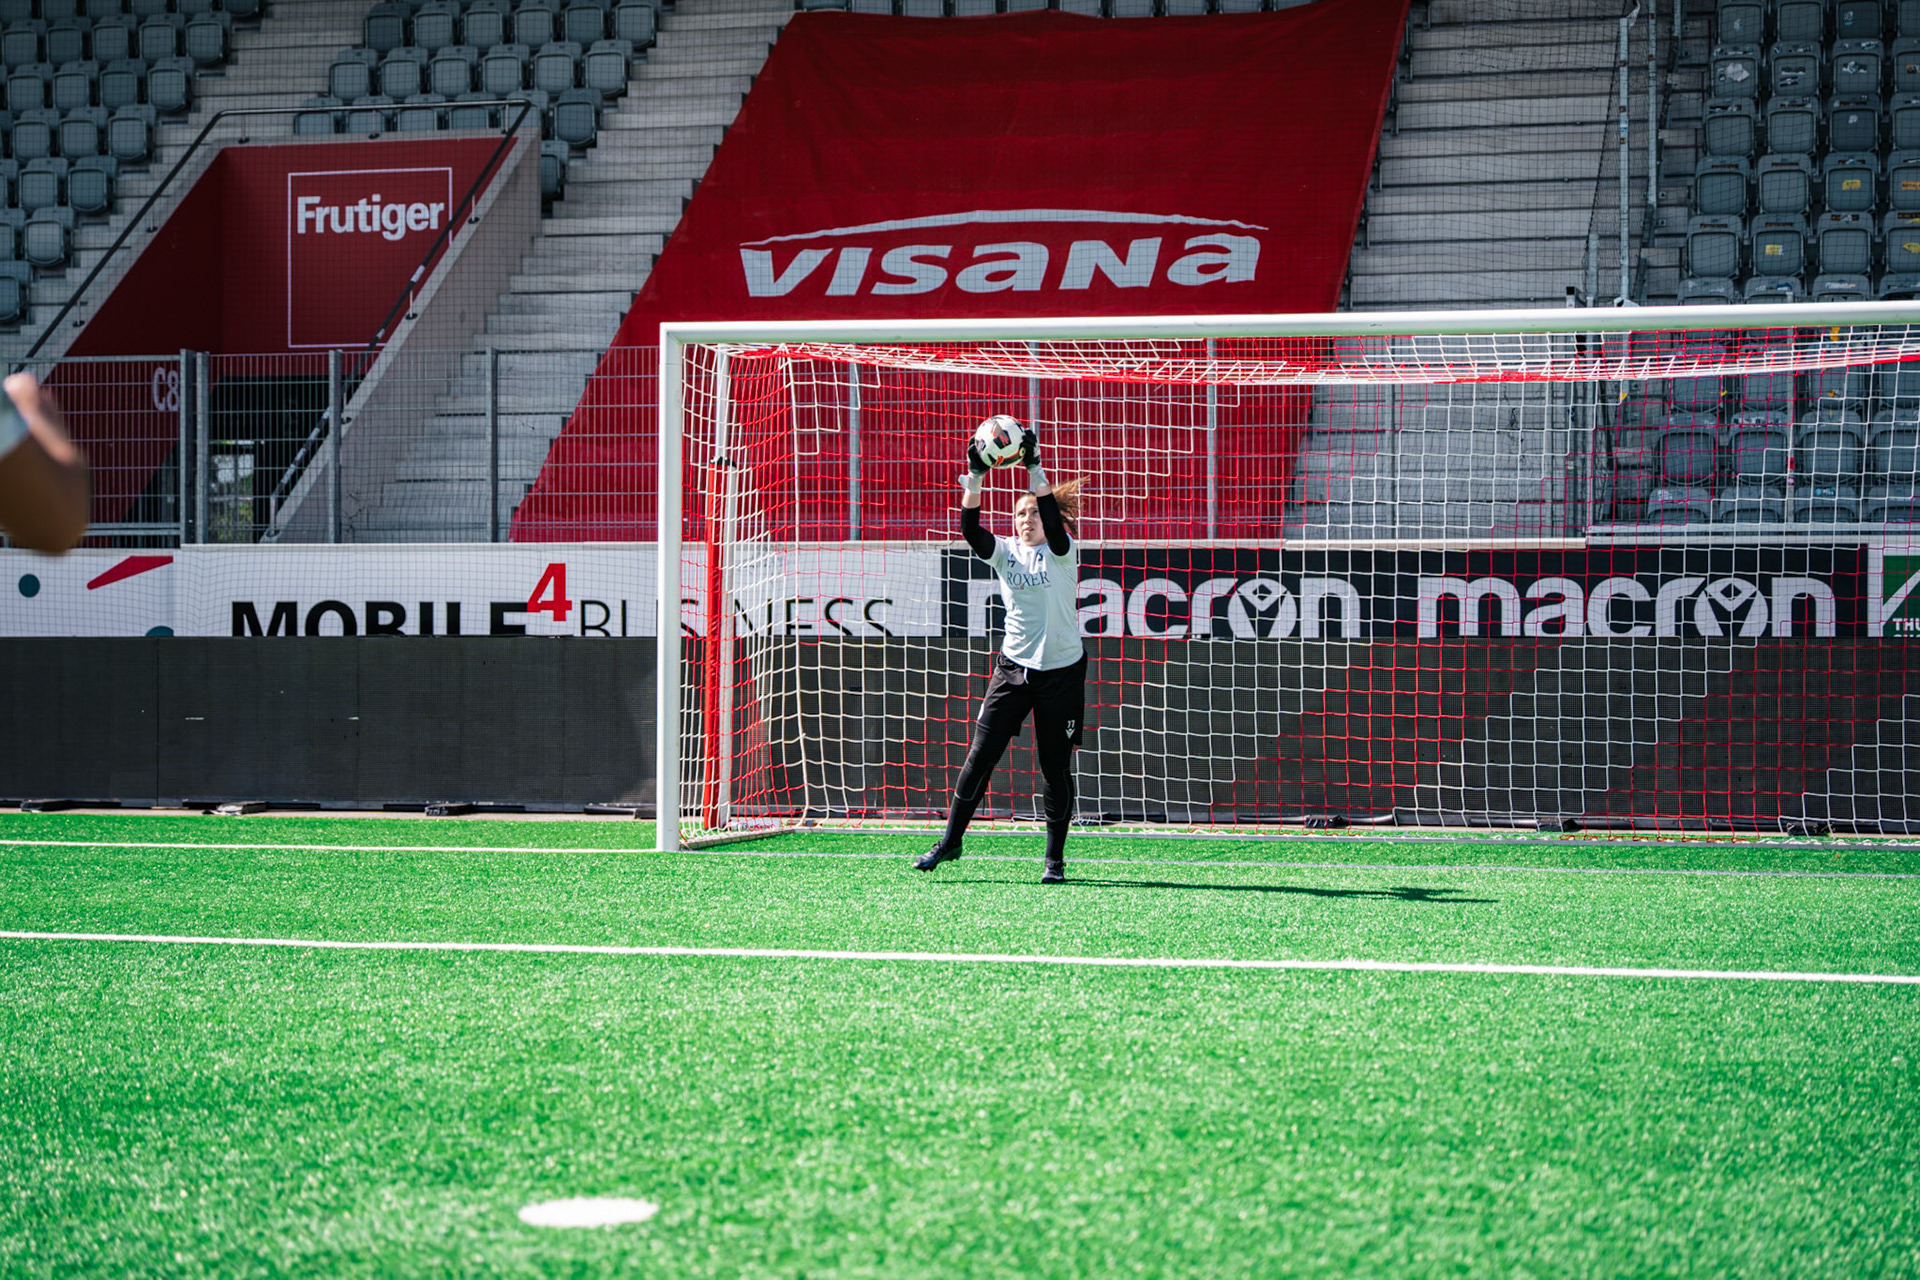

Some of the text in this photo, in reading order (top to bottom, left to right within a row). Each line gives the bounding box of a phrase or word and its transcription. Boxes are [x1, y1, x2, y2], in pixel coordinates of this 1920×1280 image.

[297, 194, 445, 241] Frutiger
[153, 366, 180, 411] C8
[1418, 577, 1837, 638] macron
